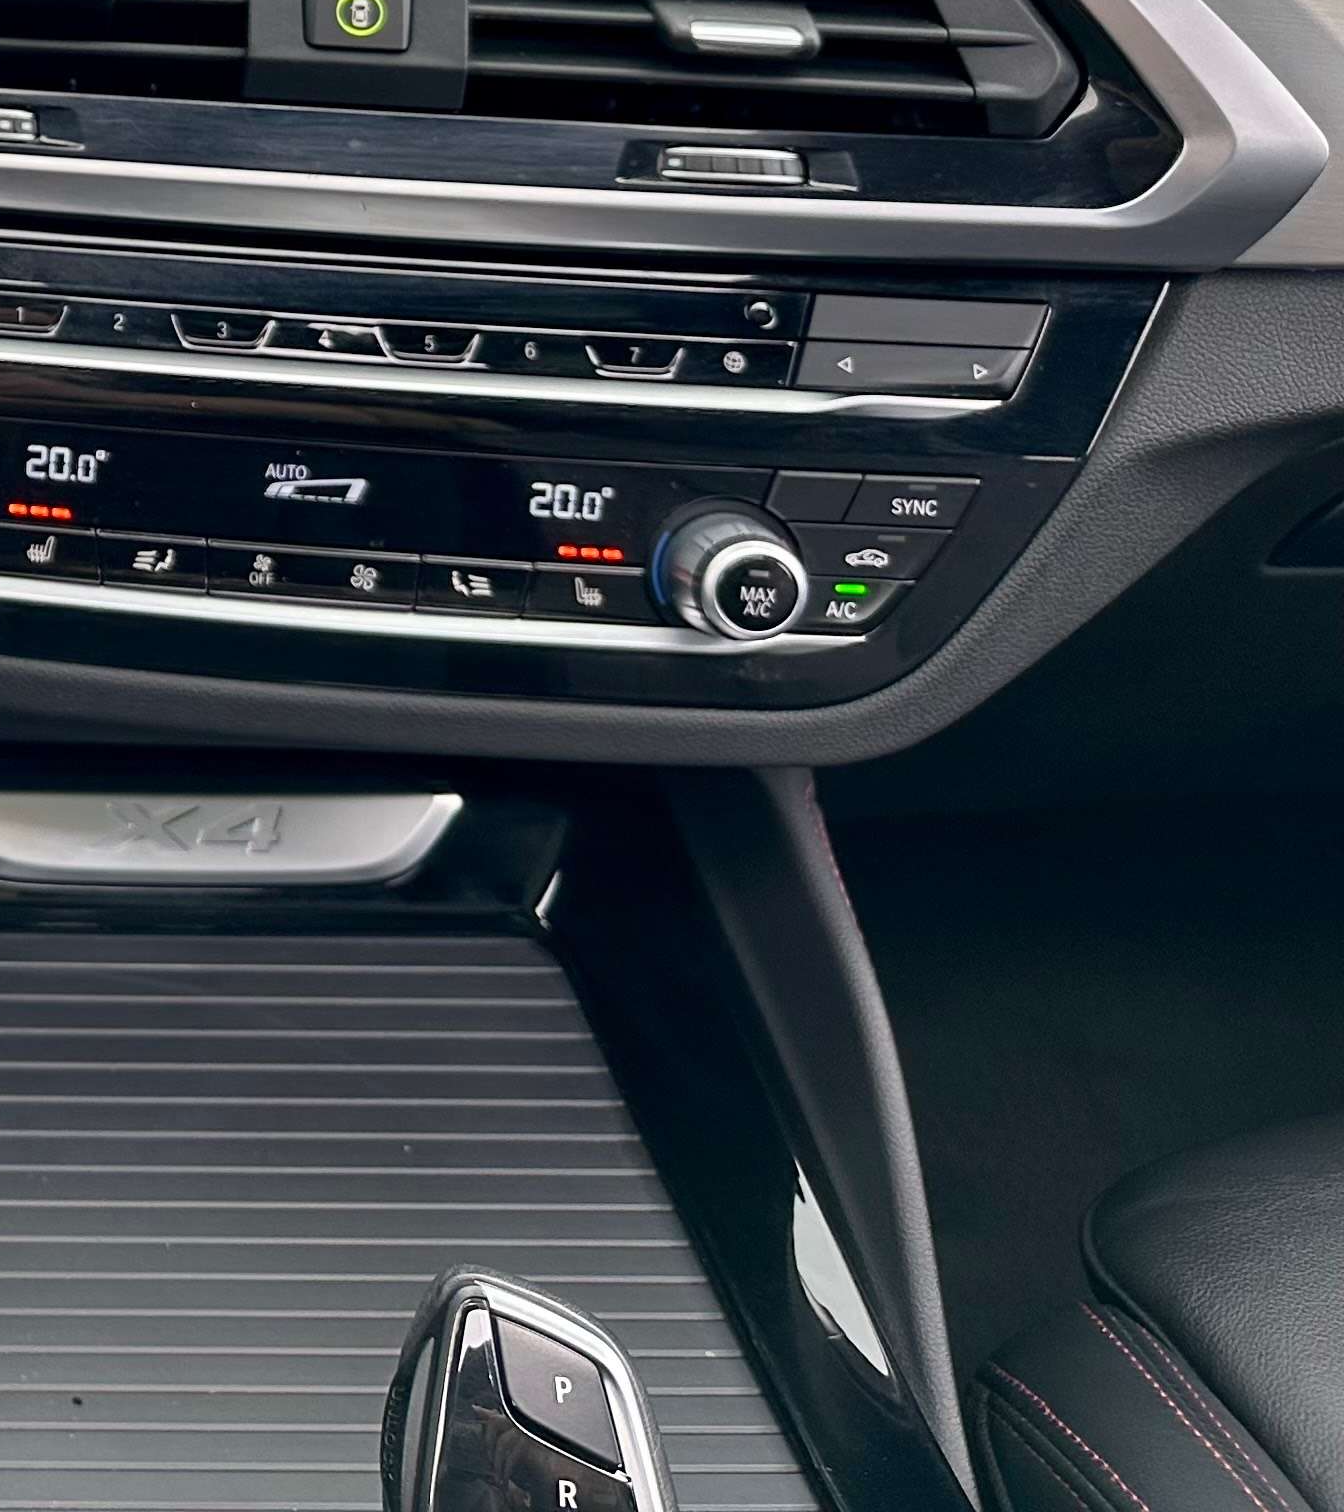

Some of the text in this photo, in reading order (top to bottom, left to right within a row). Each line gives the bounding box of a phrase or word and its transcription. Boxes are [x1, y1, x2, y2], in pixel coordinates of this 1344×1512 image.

[15, 305, 25, 323] 1
[113, 313, 126, 331] 2
[216, 321, 230, 339] 3
[424, 334, 438, 353] 5
[524, 341, 539, 360] 6
[628, 346, 642, 364] 7
[264, 462, 310, 480] AUTO
[890, 497, 938, 517] SYNC
[248, 572, 276, 587] OFF
[739, 586, 776, 603] MAX
[743, 600, 771, 618] A/C
[826, 600, 858, 619] A/C
[89, 802, 285, 854] X4
[553, 1375, 573, 1403] P
[557, 1479, 579, 1509] R
